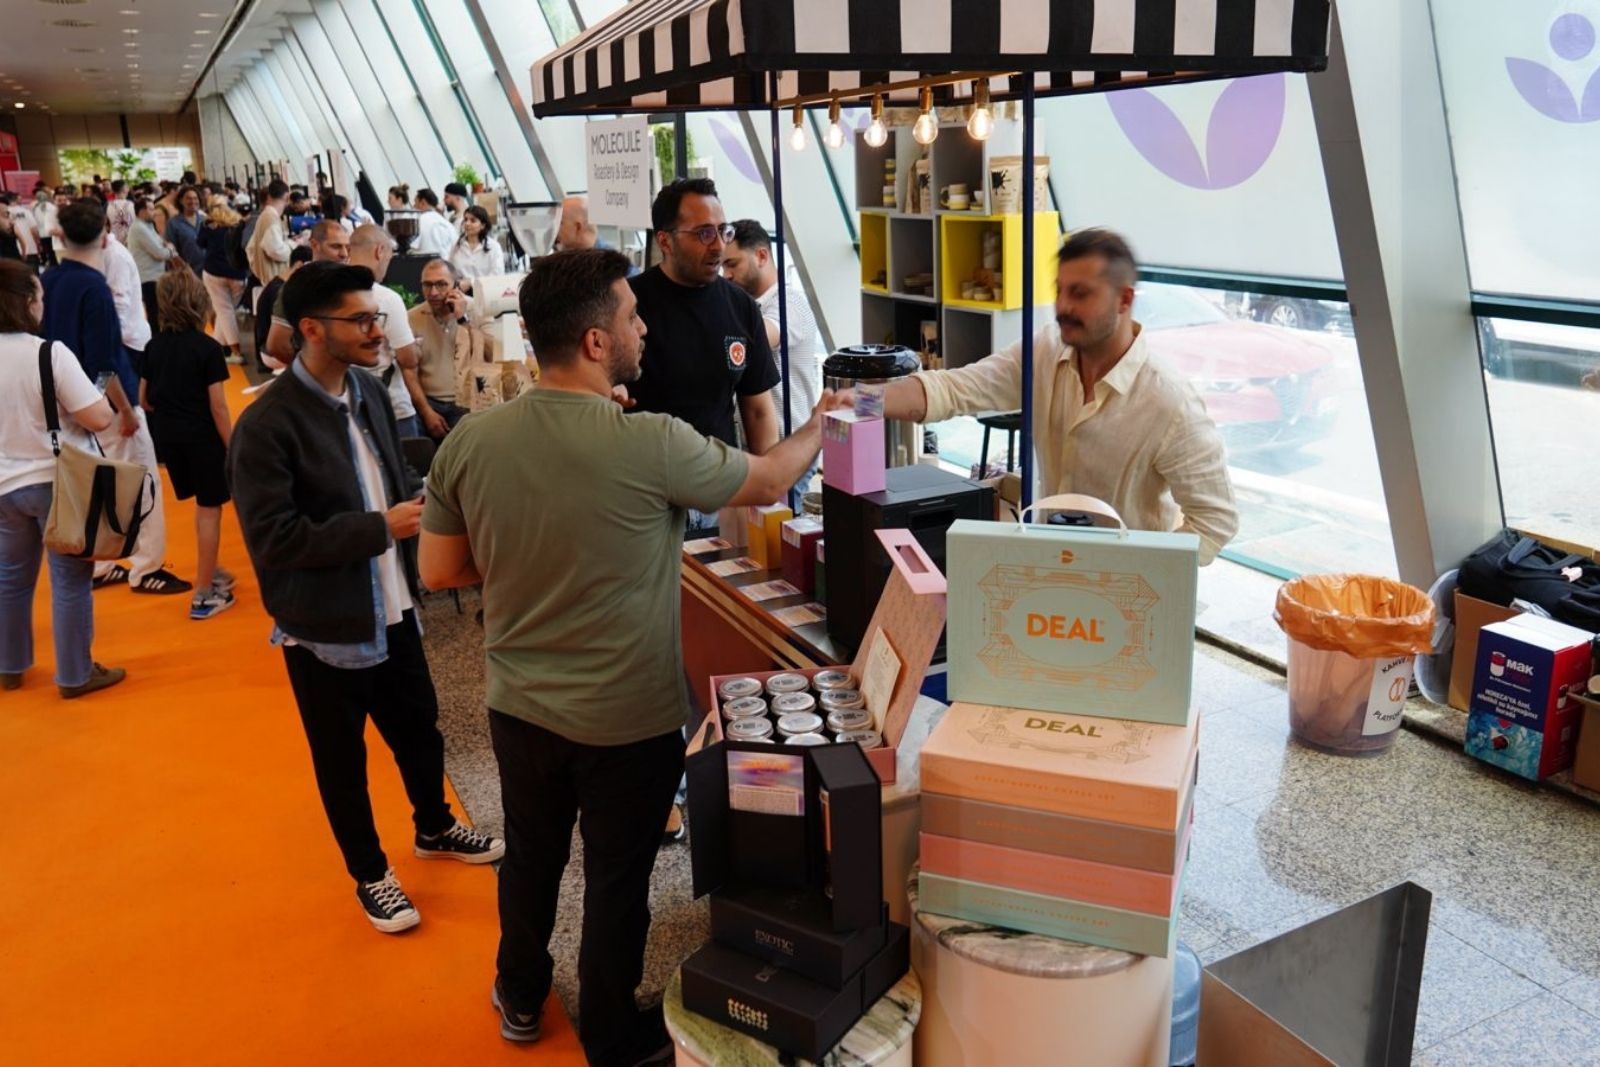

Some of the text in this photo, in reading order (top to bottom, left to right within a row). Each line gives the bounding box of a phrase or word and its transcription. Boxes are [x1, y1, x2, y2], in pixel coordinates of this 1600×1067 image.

[591, 130, 641, 155] MOLECULE
[605, 189, 629, 208] Company
[1027, 613, 1104, 643] DEAL
[1024, 717, 1102, 738] DEAL
